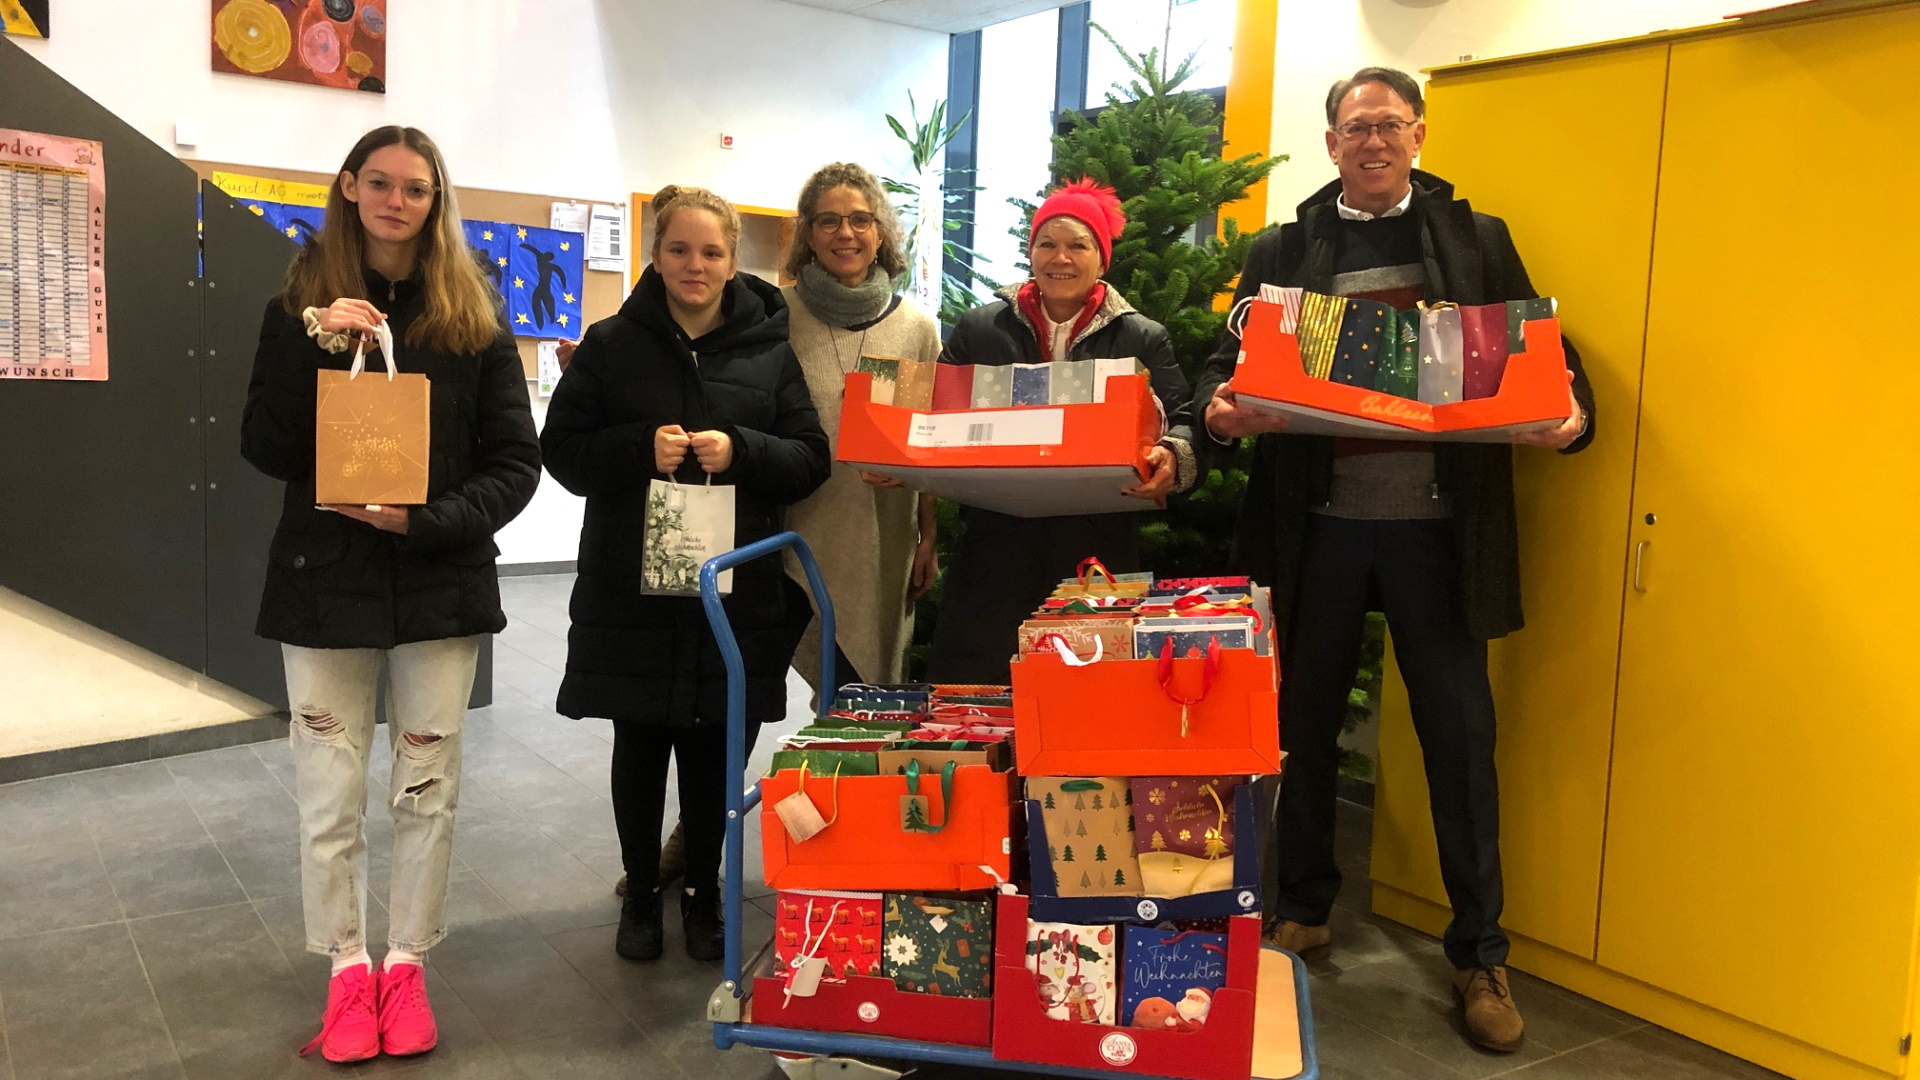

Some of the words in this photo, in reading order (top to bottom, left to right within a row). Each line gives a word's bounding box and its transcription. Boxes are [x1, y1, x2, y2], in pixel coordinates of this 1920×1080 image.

[94, 286, 103, 334] GUTE
[1148, 943, 1191, 967] Frohe
[1134, 960, 1223, 989] Weihnachten
